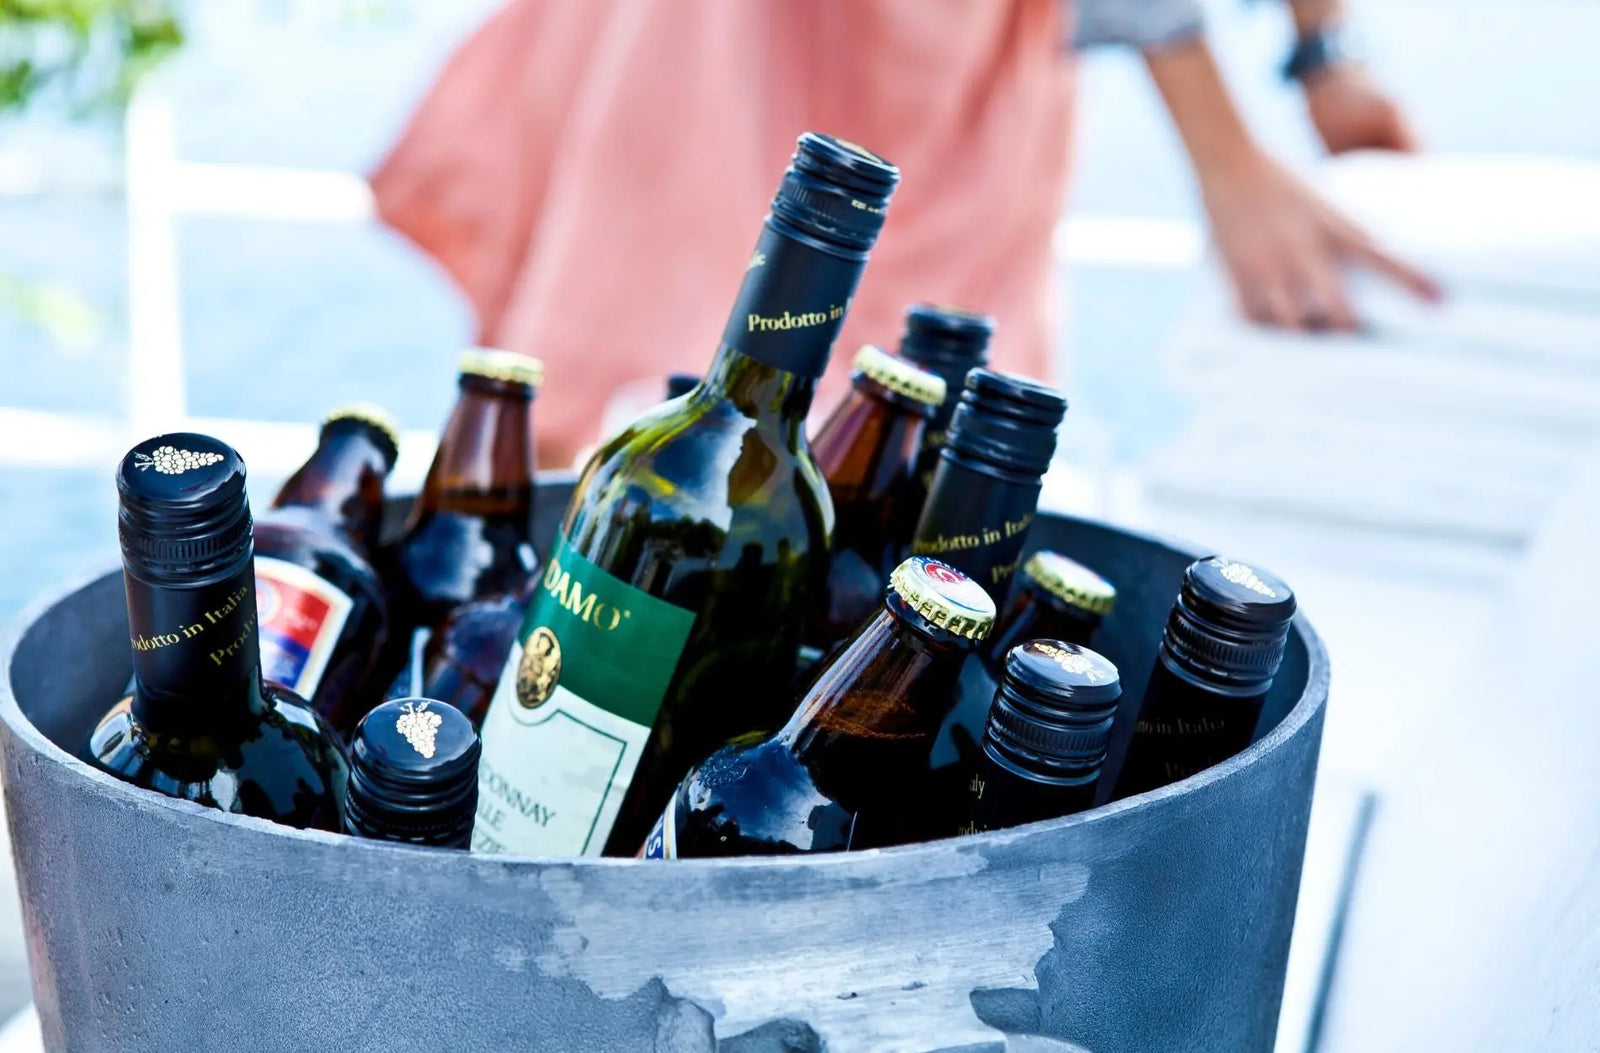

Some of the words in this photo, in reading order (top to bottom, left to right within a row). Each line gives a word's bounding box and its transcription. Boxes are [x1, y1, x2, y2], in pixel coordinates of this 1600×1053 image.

[748, 311, 827, 332] Prodotto
[830, 304, 843, 319] in
[982, 527, 1001, 545] in
[179, 624, 204, 639] in
[204, 585, 248, 624] Italia
[969, 773, 985, 799] aly
